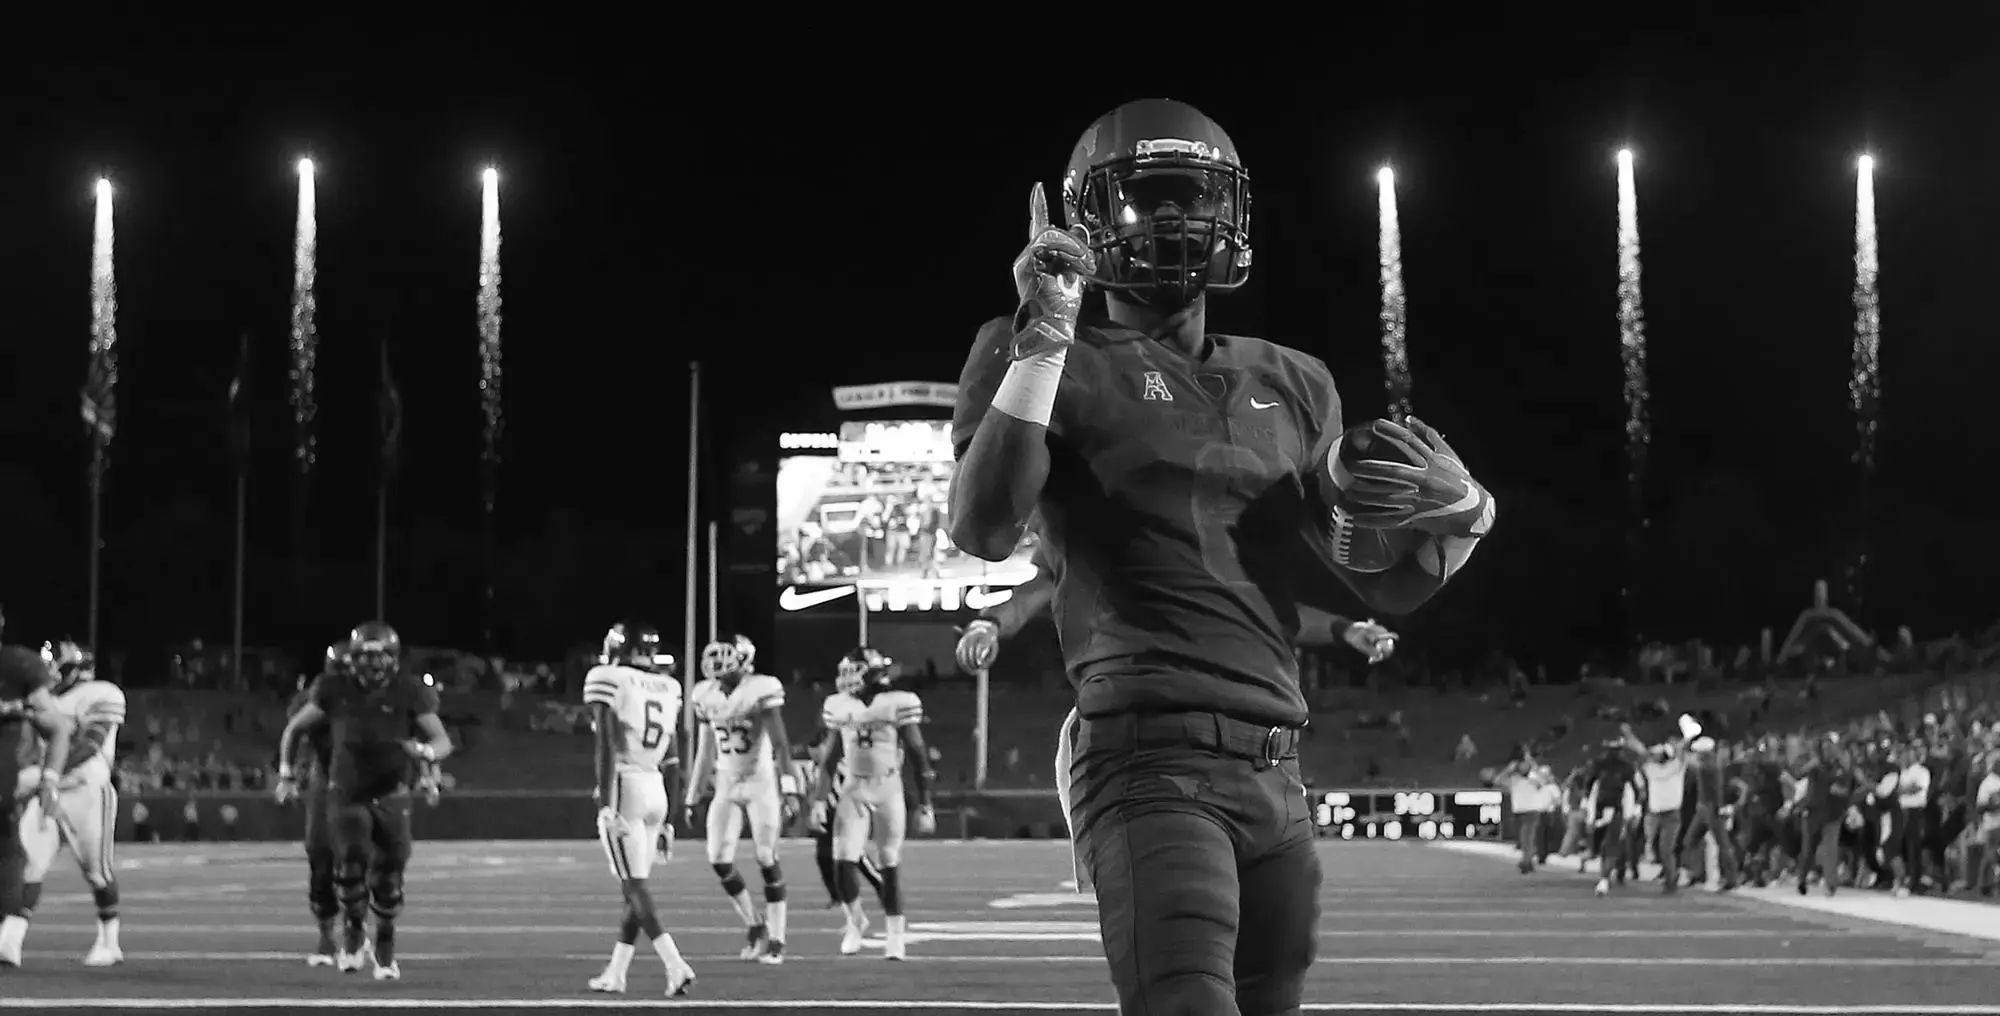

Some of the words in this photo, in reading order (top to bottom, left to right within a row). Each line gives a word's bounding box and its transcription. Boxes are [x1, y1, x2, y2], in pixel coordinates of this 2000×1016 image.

[1143, 371, 1173, 402] A
[643, 701, 663, 749] 6
[716, 726, 753, 755] 23
